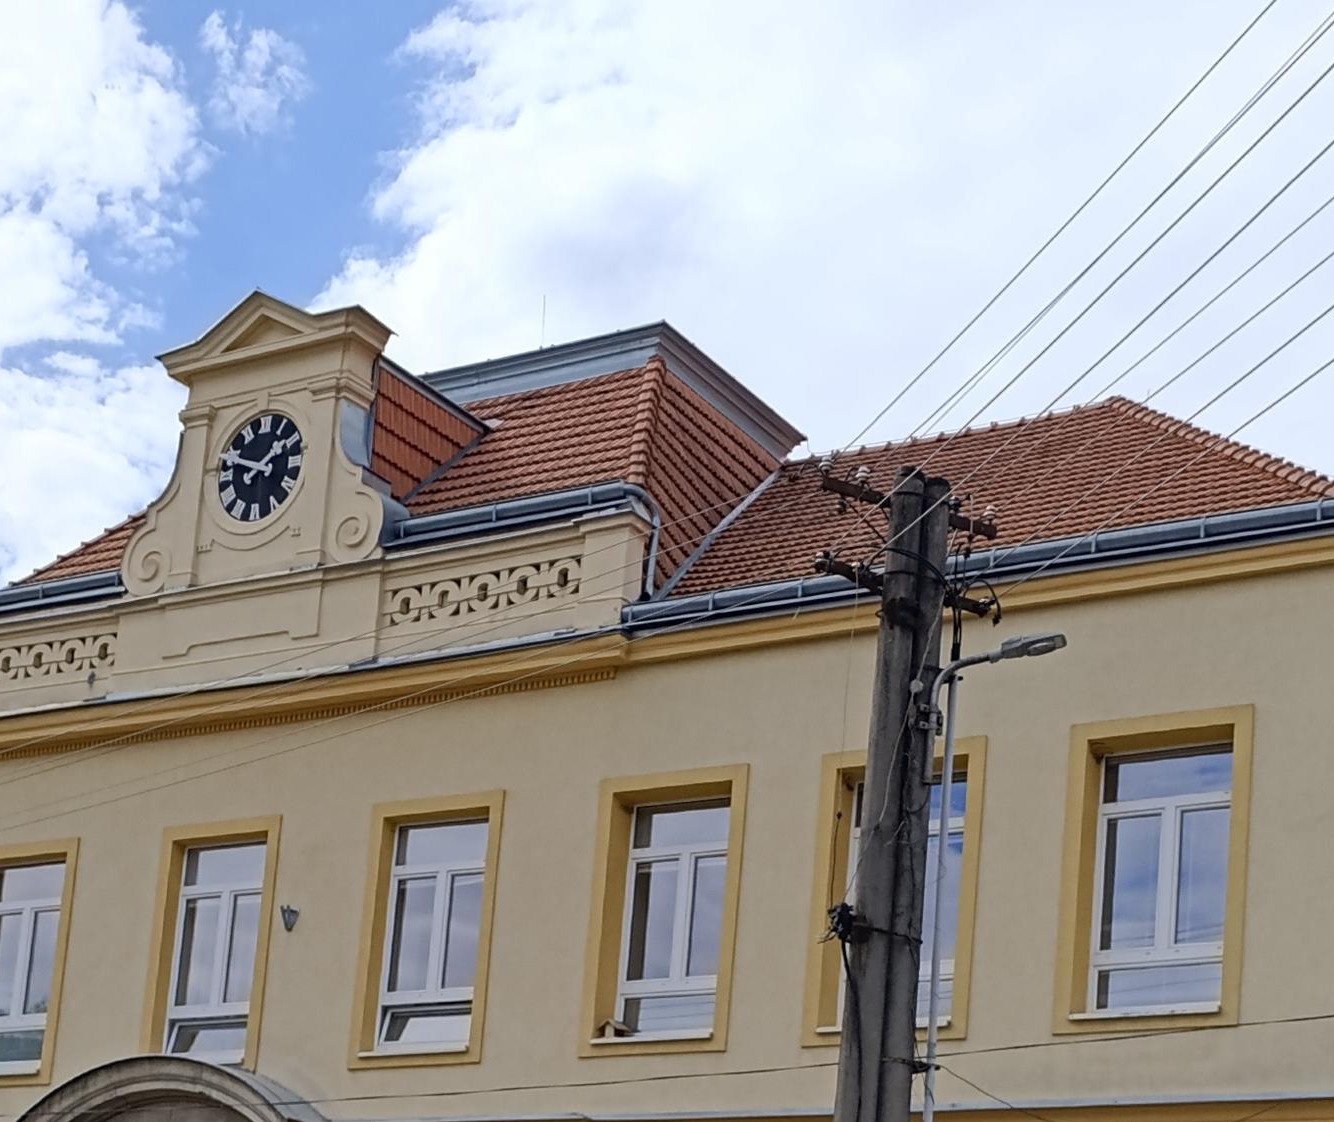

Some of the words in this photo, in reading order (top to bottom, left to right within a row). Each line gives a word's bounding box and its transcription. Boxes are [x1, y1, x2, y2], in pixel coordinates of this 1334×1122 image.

[258, 416, 272, 433] XII
[275, 419, 287, 434] I
[241, 425, 254, 444] XI
[285, 432, 299, 448] II
[288, 455, 301, 468] III
[281, 476, 296, 492] IV
[249, 504, 259, 519] VI
[269, 496, 280, 512] V
